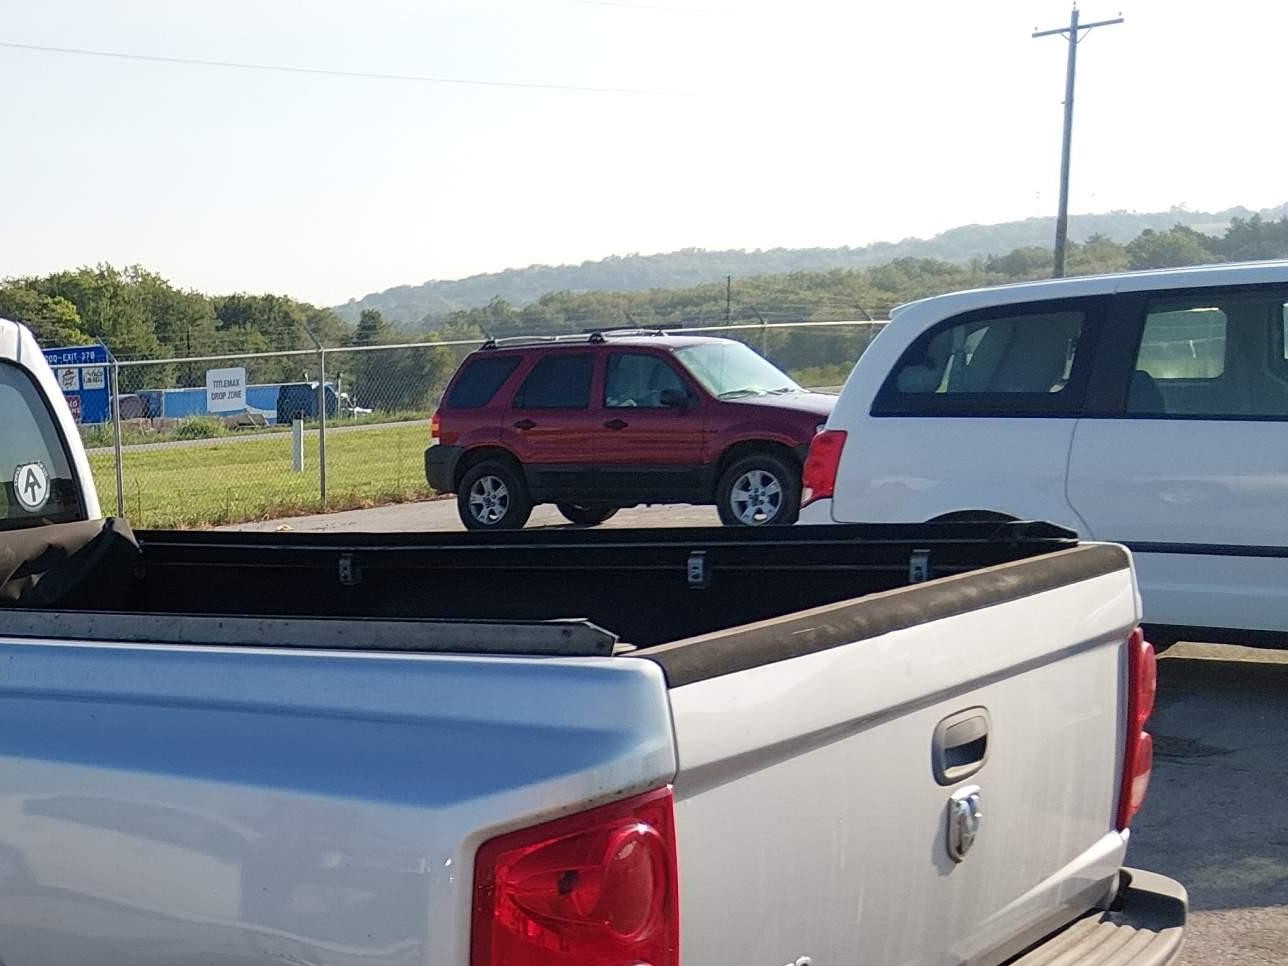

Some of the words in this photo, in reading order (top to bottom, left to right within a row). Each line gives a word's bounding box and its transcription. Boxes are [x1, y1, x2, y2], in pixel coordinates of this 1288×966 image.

[213, 379, 239, 388] TITLEMAX
[211, 391, 226, 400] DROP
[228, 390, 242, 399] ZONE
